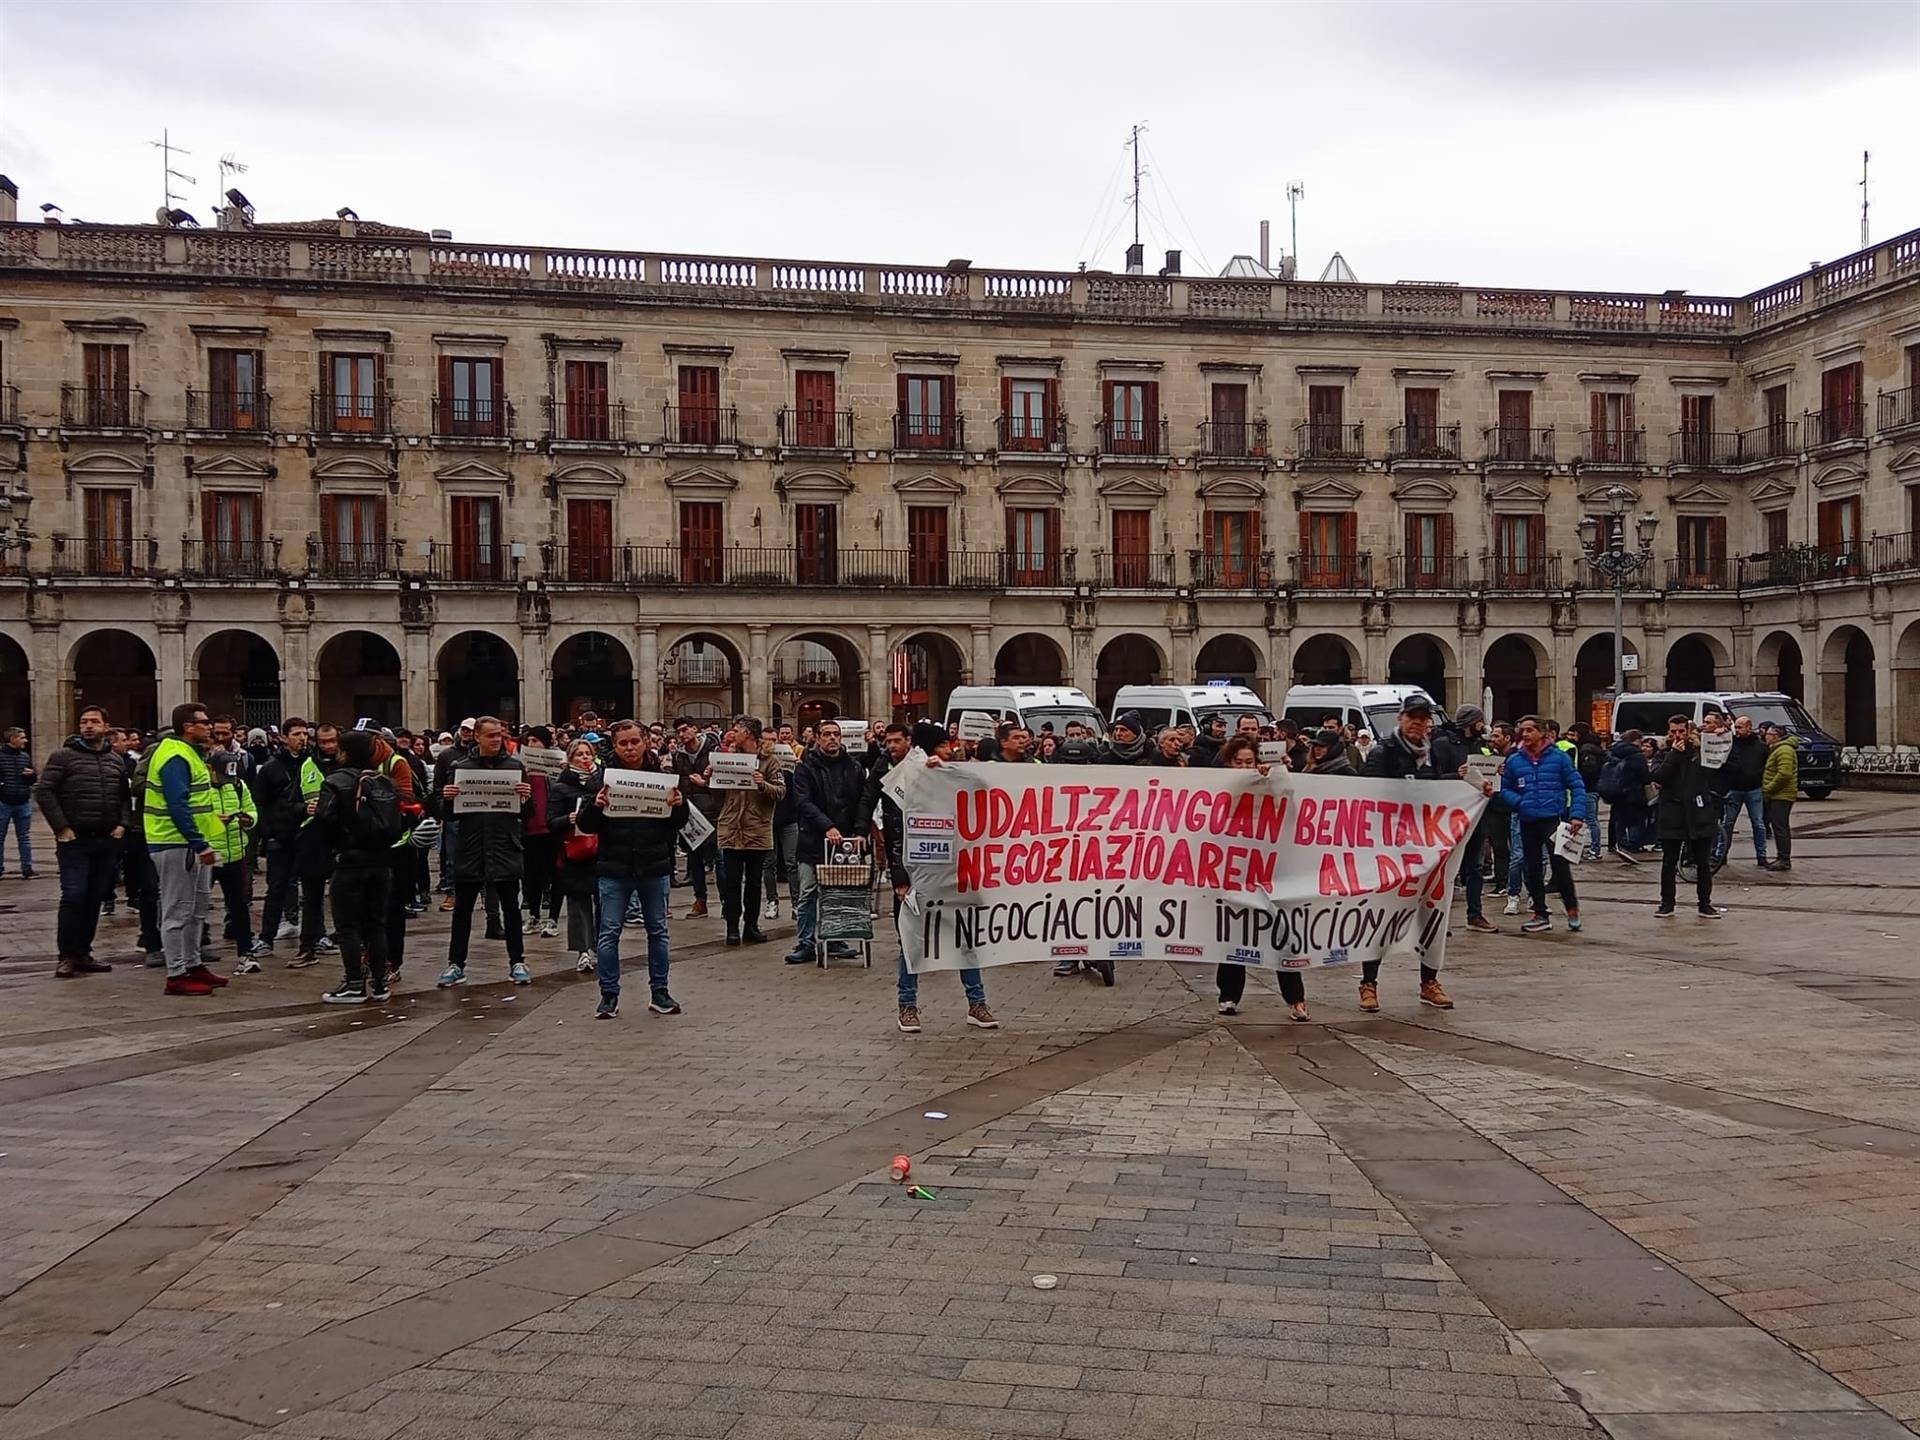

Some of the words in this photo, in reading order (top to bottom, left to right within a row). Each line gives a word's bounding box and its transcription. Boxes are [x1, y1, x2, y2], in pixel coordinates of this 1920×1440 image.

[616, 780, 644, 788] MAIDER
[956, 779, 1287, 843] UDALTZAINGOAN
[1294, 798, 1471, 848] BENETAKO
[918, 820, 943, 828] CCOO
[919, 842, 949, 852] SIPLA
[957, 832, 1278, 893] NEGOZIAZIOAREN
[955, 884, 1143, 949] NEGOCIACIÓN
[1155, 898, 1188, 940] SI
[1117, 942, 1142, 951] SIPLA
[1235, 948, 1260, 959] SIPLA
